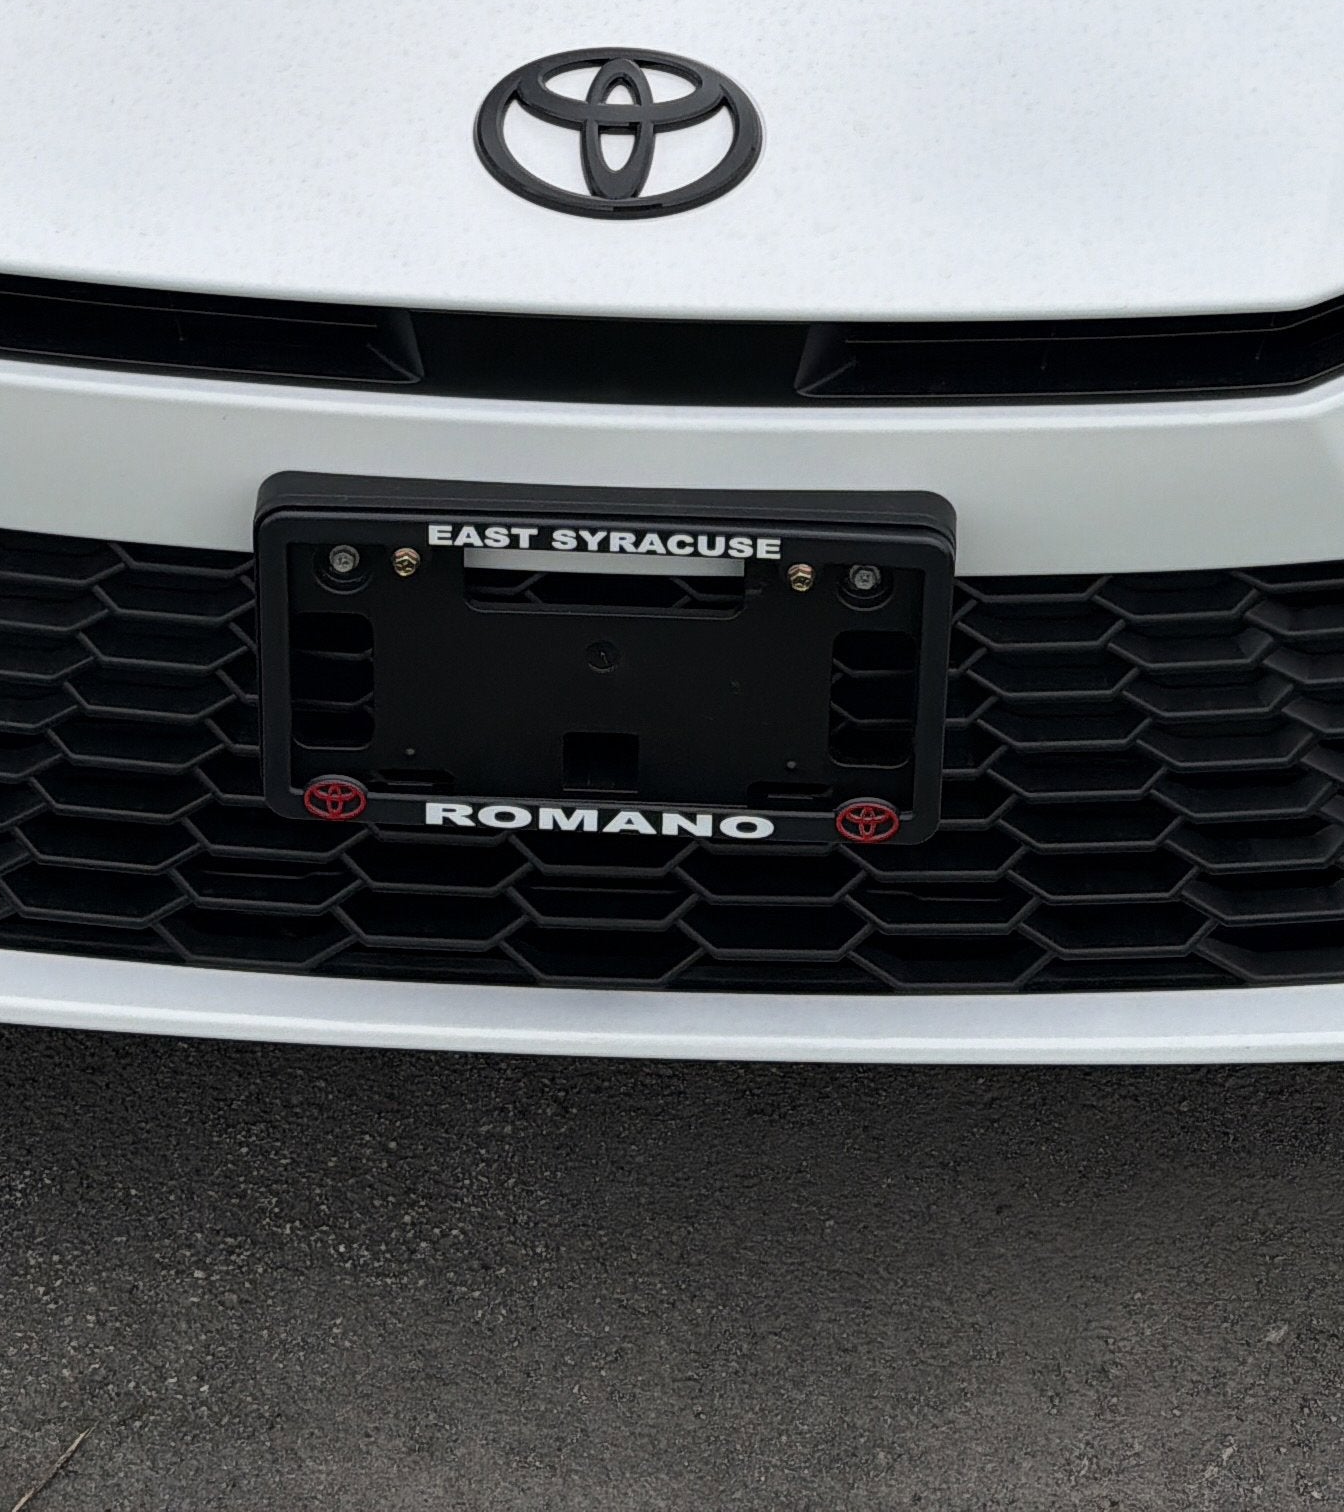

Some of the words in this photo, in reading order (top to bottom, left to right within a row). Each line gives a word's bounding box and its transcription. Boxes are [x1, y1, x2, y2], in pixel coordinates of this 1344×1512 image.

[428, 525, 538, 549] EAST
[552, 530, 781, 559] SYRACUSE
[425, 802, 775, 838] ROMANO
